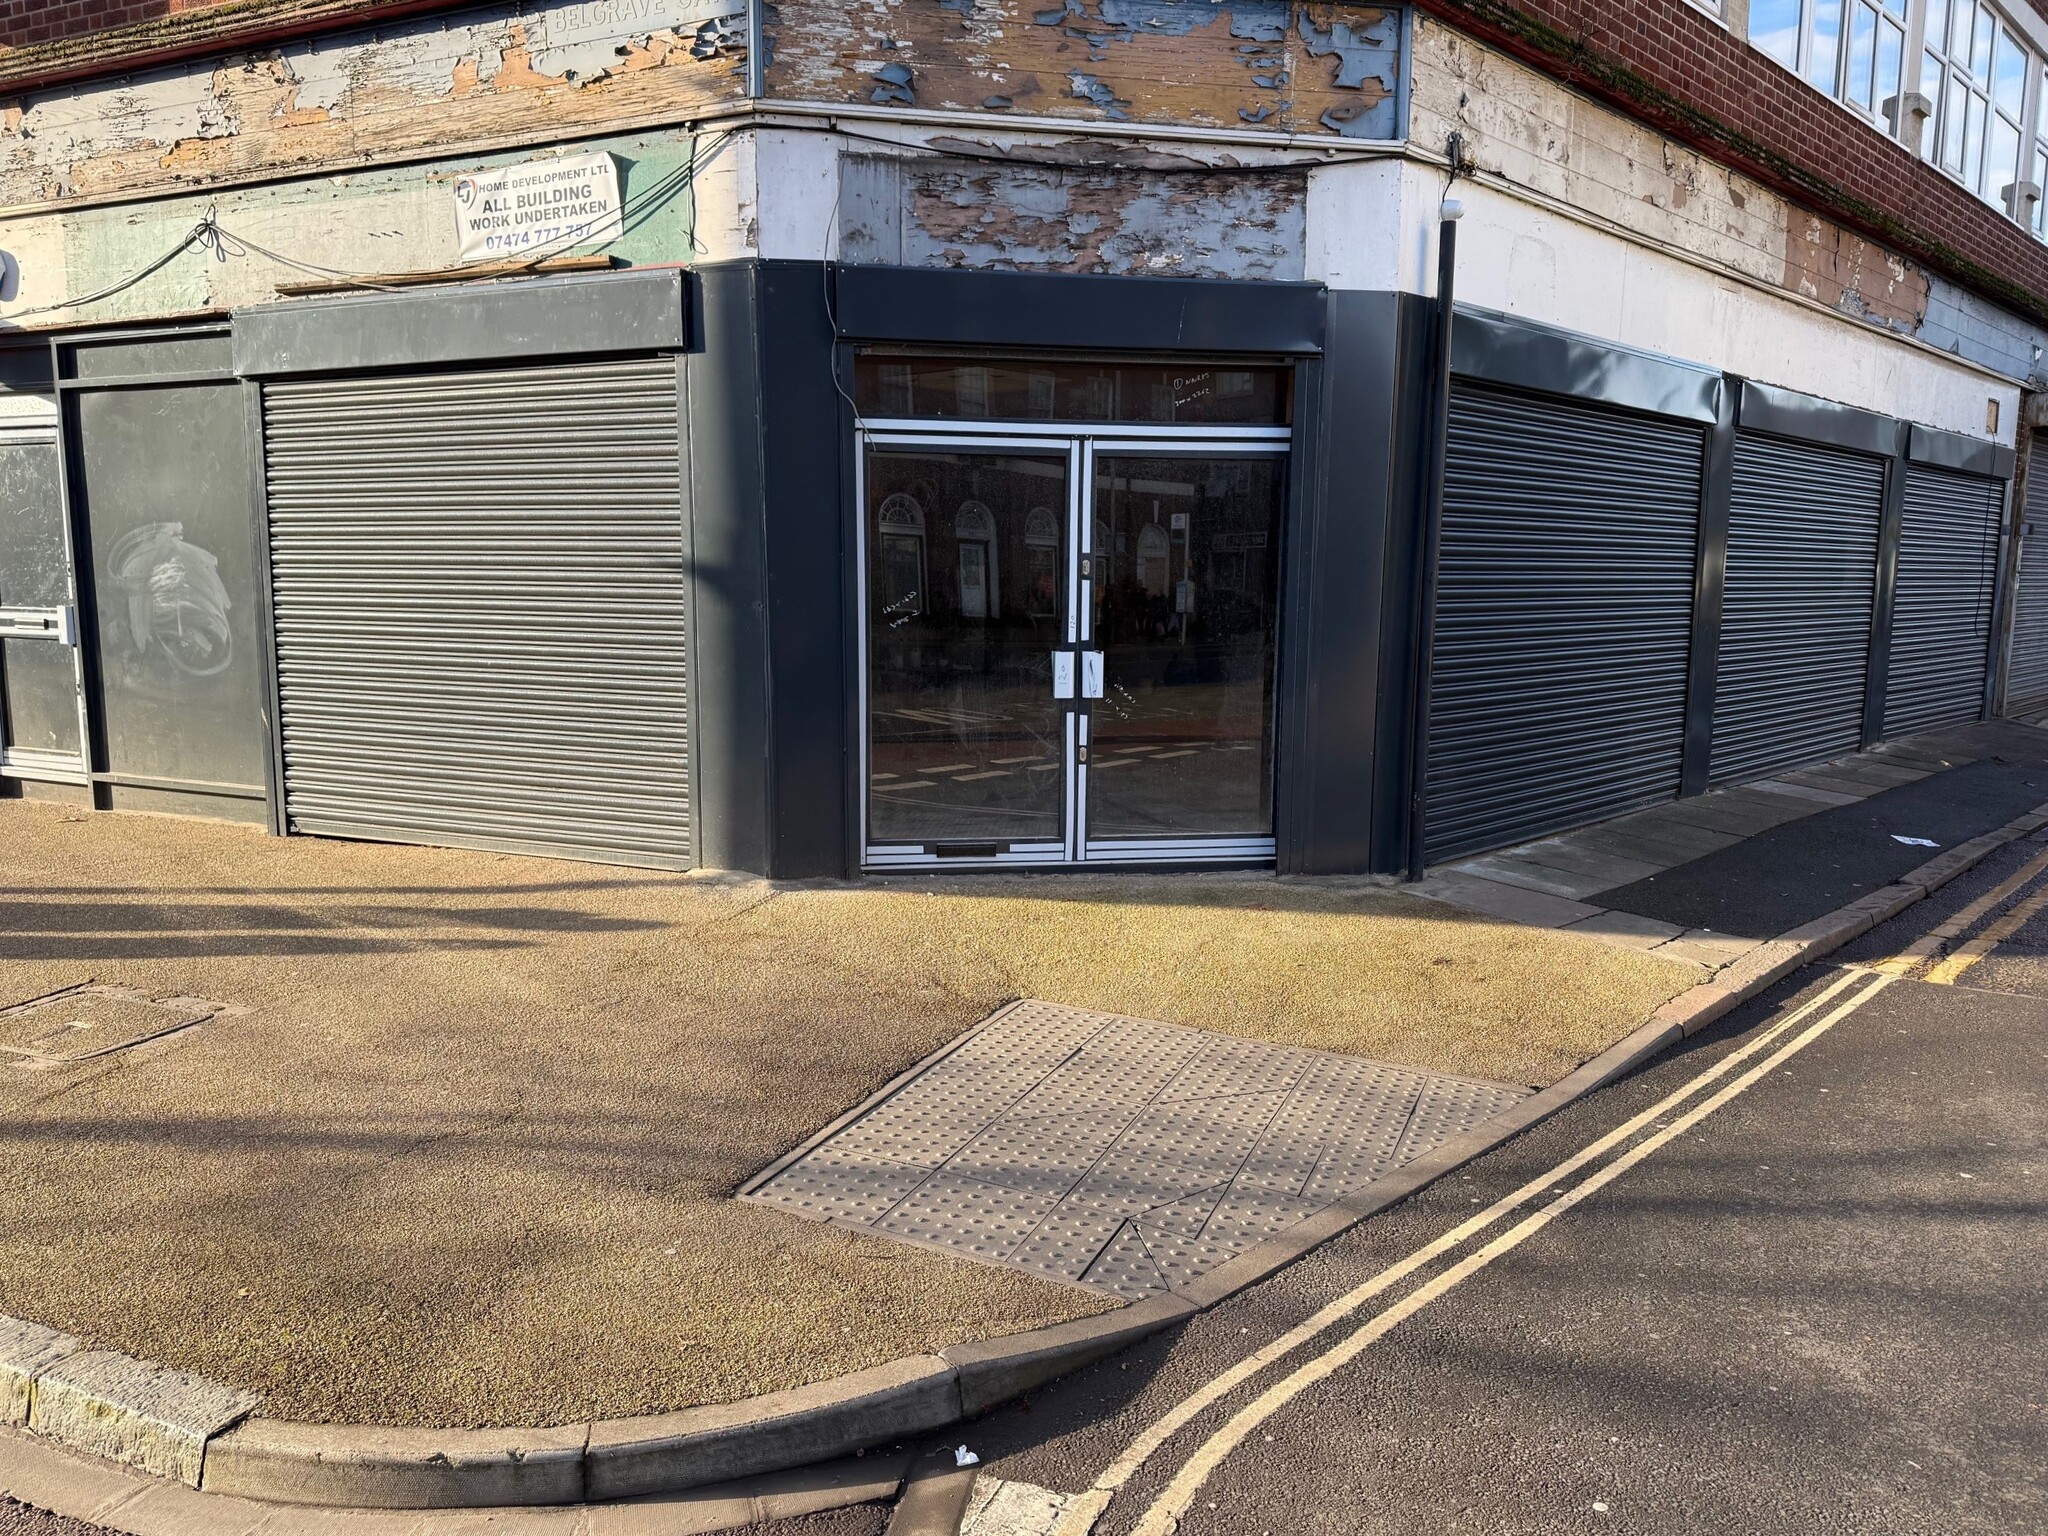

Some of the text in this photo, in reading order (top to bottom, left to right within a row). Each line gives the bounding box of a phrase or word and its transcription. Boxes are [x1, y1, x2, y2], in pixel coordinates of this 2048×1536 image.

[554, 0, 666, 33] BELGRAVE
[479, 180, 509, 193] HOME
[512, 167, 588, 189] DEVELOPMENT
[482, 184, 593, 214] ALL BUILDING
[469, 199, 608, 231] WORK UNDERTAKEN
[486, 231, 530, 250] 07474
[535, 226, 561, 243] 777
